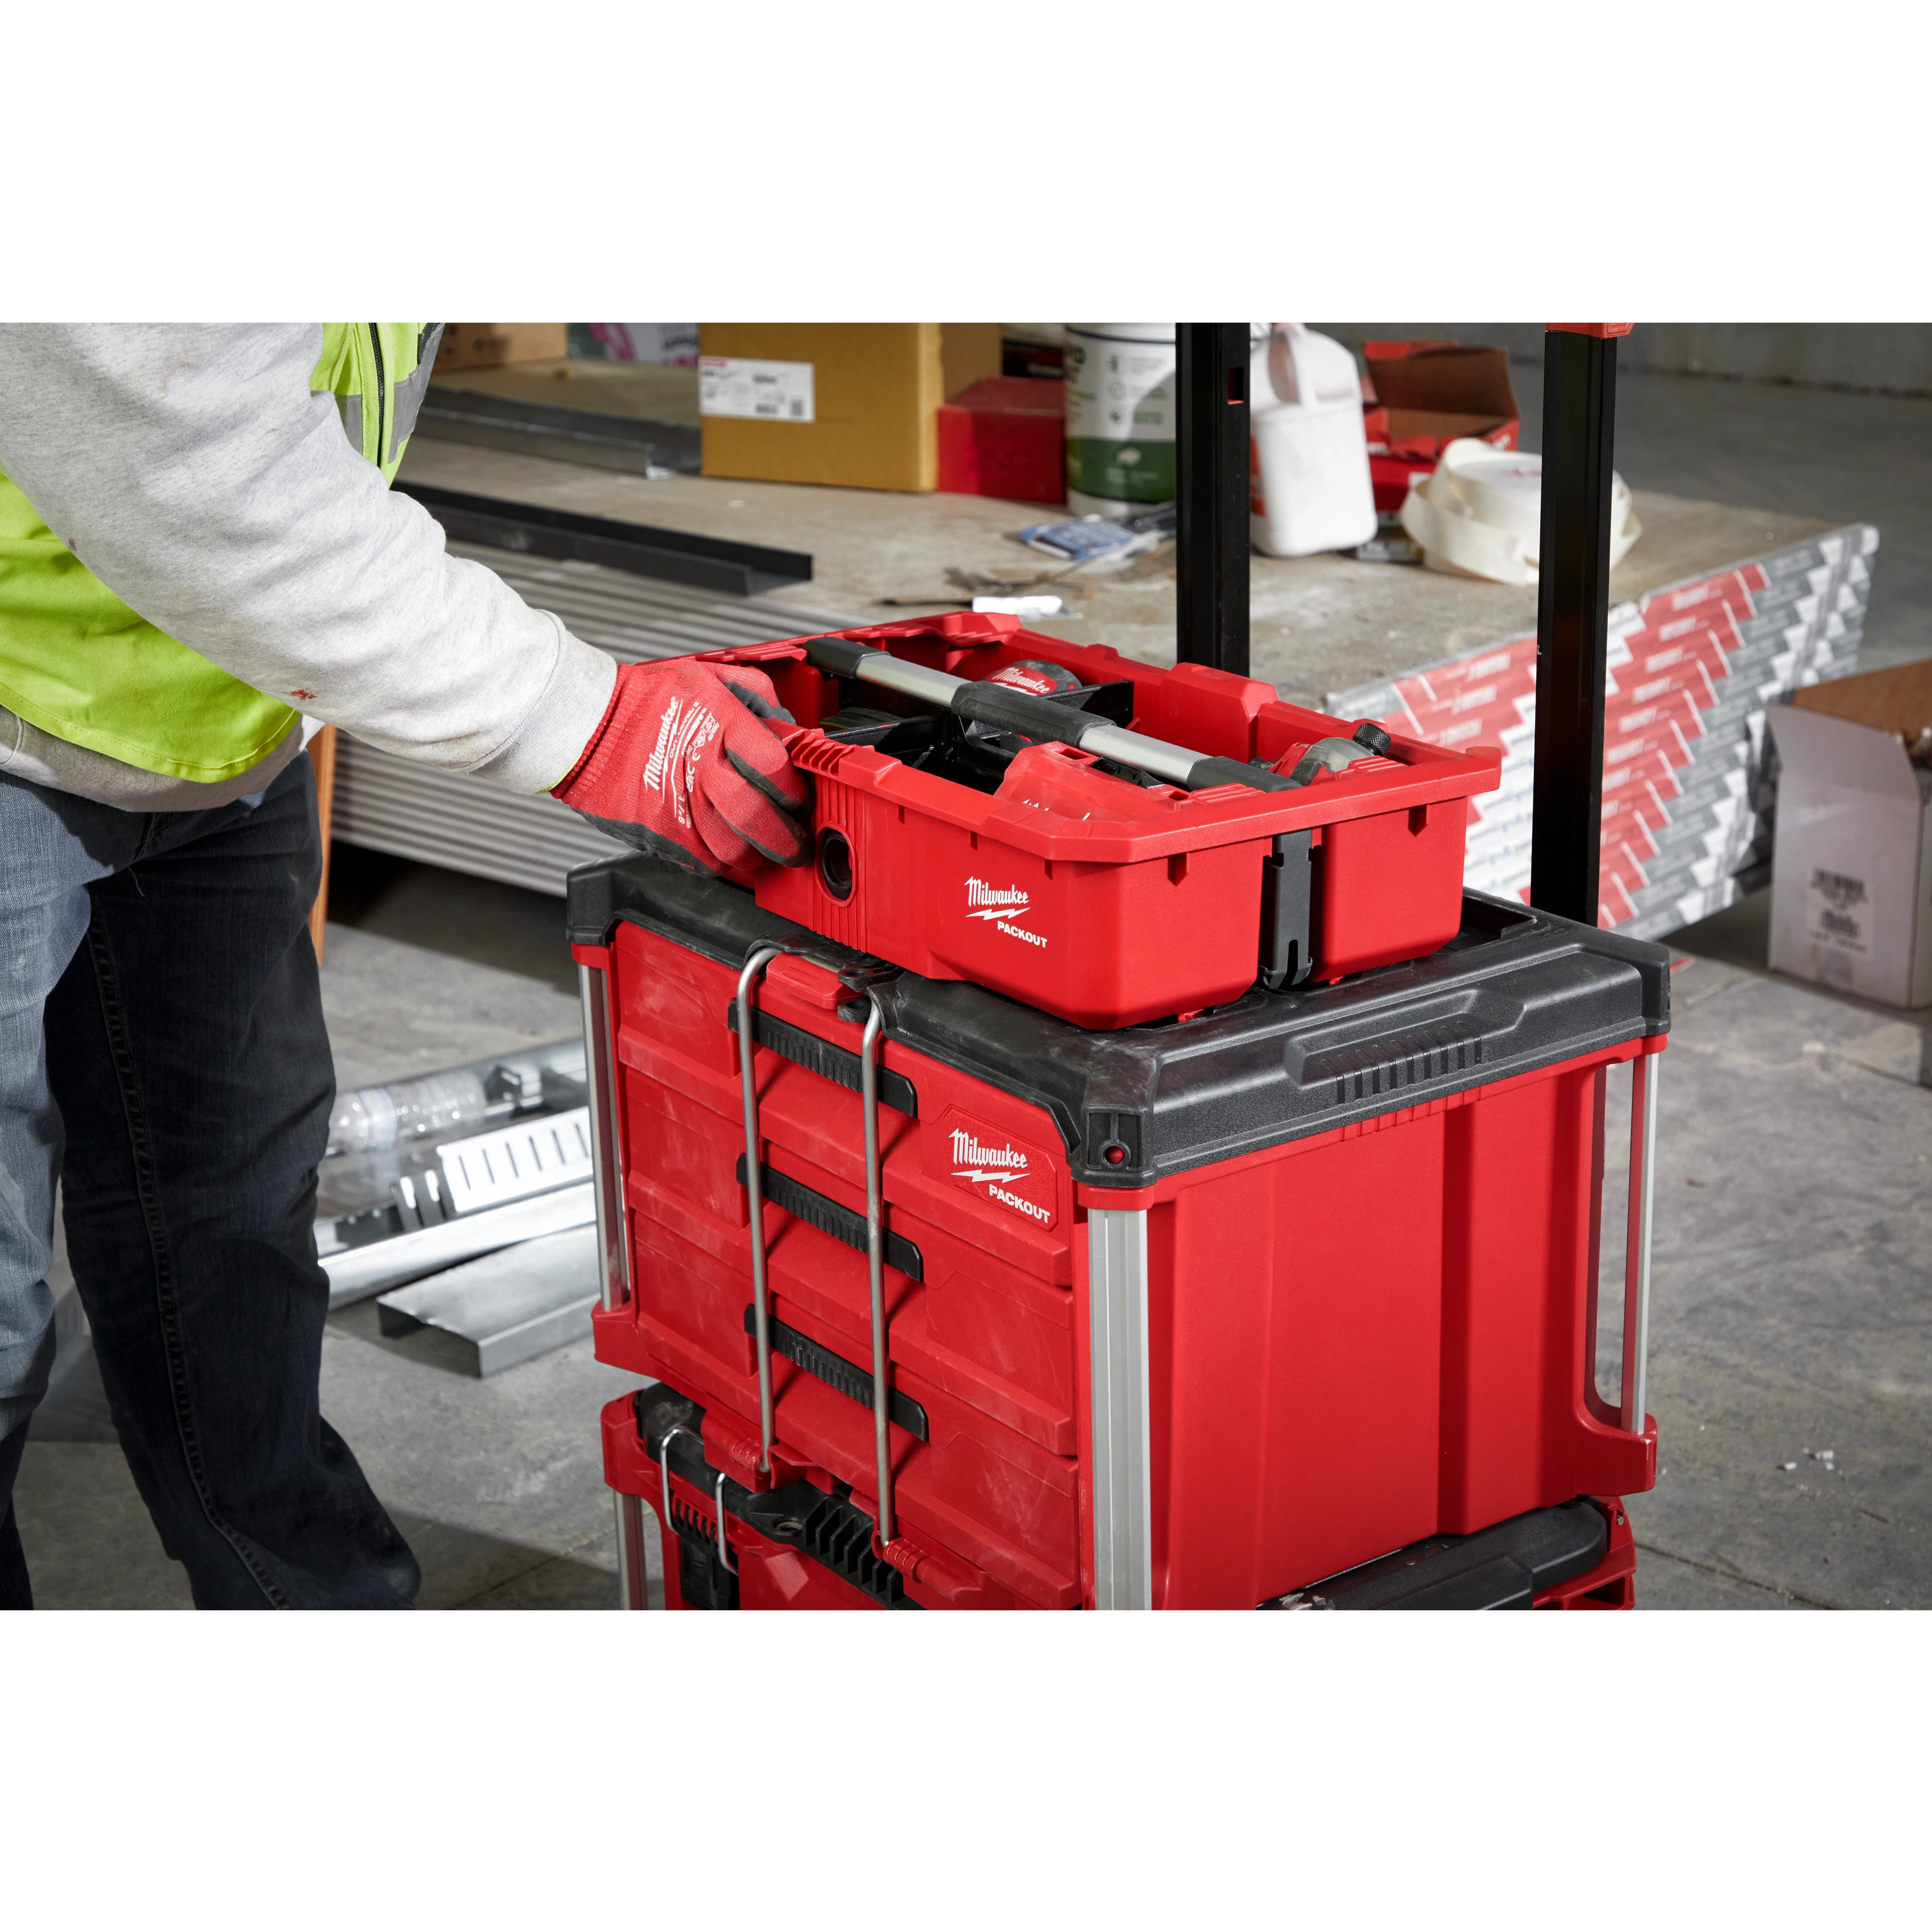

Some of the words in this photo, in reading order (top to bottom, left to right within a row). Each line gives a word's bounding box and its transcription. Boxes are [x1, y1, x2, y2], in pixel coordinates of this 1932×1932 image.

[992, 667, 1051, 694] Milwaukee
[669, 739, 678, 758] CUT
[677, 708, 695, 735] LEVEL
[964, 876, 1029, 907] Milwaukee
[997, 920, 1048, 948] PACKOUT
[948, 1128, 1028, 1168] Milwaukee
[989, 1184, 1051, 1223] PACKOUT
